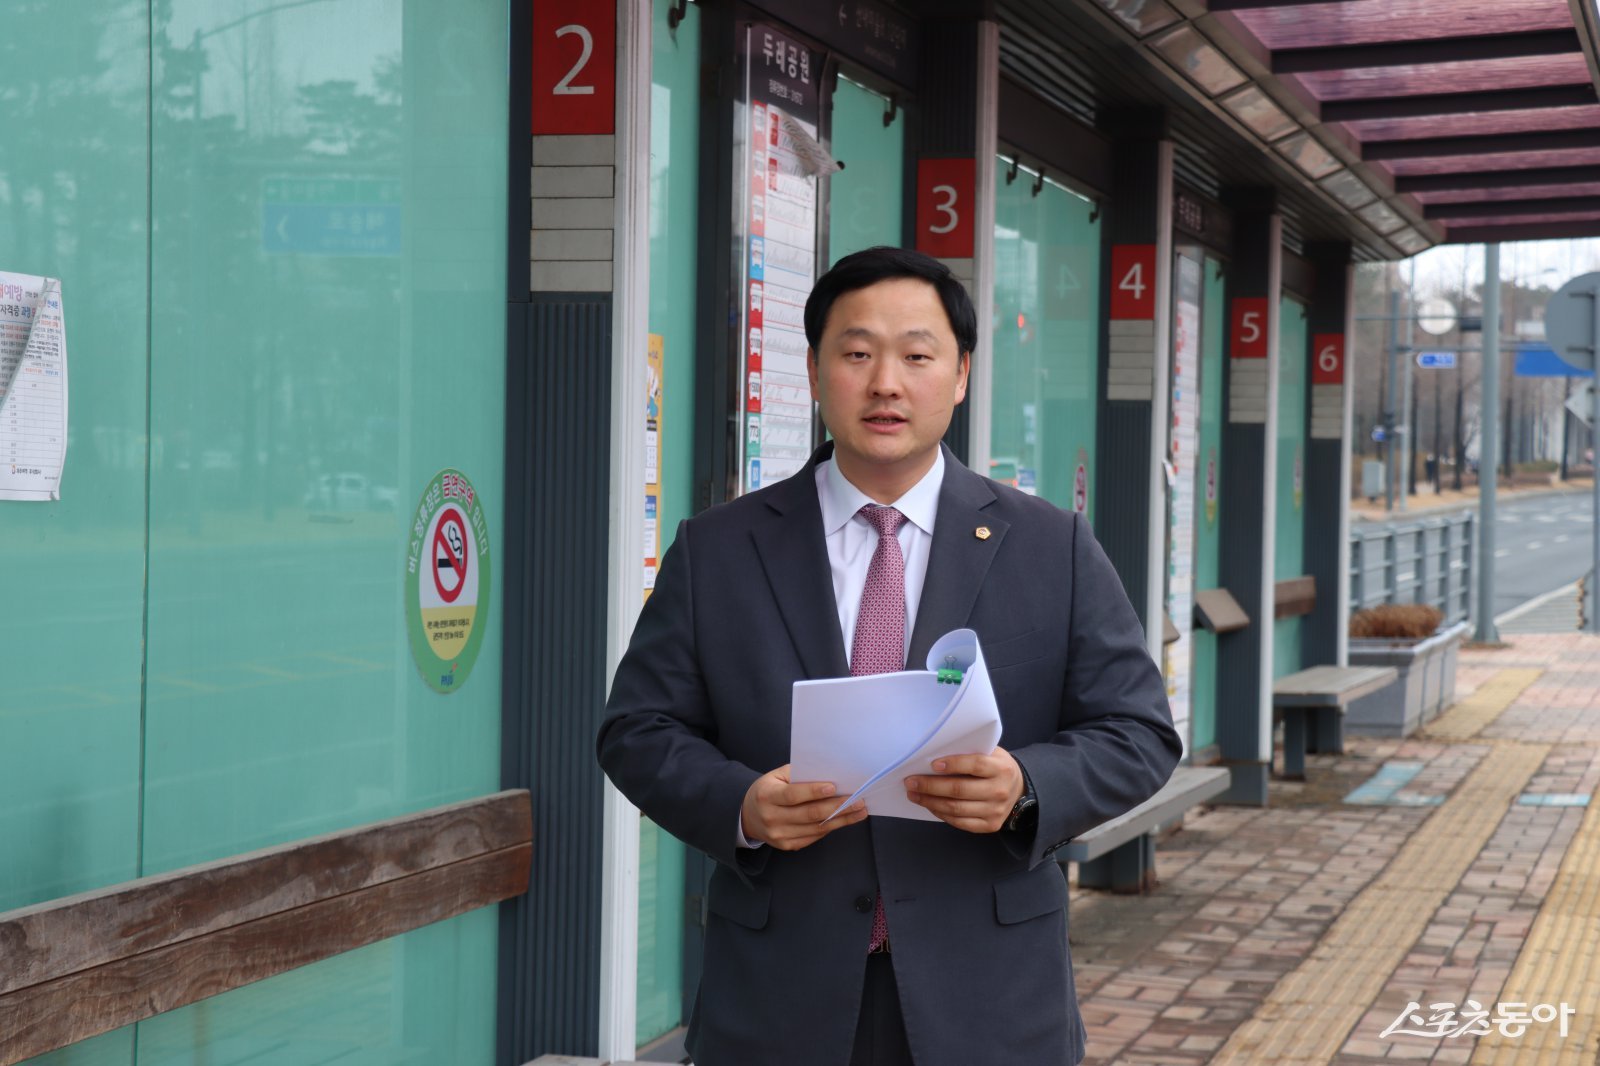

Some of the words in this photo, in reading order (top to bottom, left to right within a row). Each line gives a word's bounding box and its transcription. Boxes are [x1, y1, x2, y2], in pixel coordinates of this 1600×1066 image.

[553, 24, 594, 95] 2
[929, 185, 959, 234] 3
[1118, 262, 1146, 300] 4
[1240, 312, 1260, 343] 5
[1318, 344, 1338, 372] 6
[442, 473, 476, 512] 금연구역
